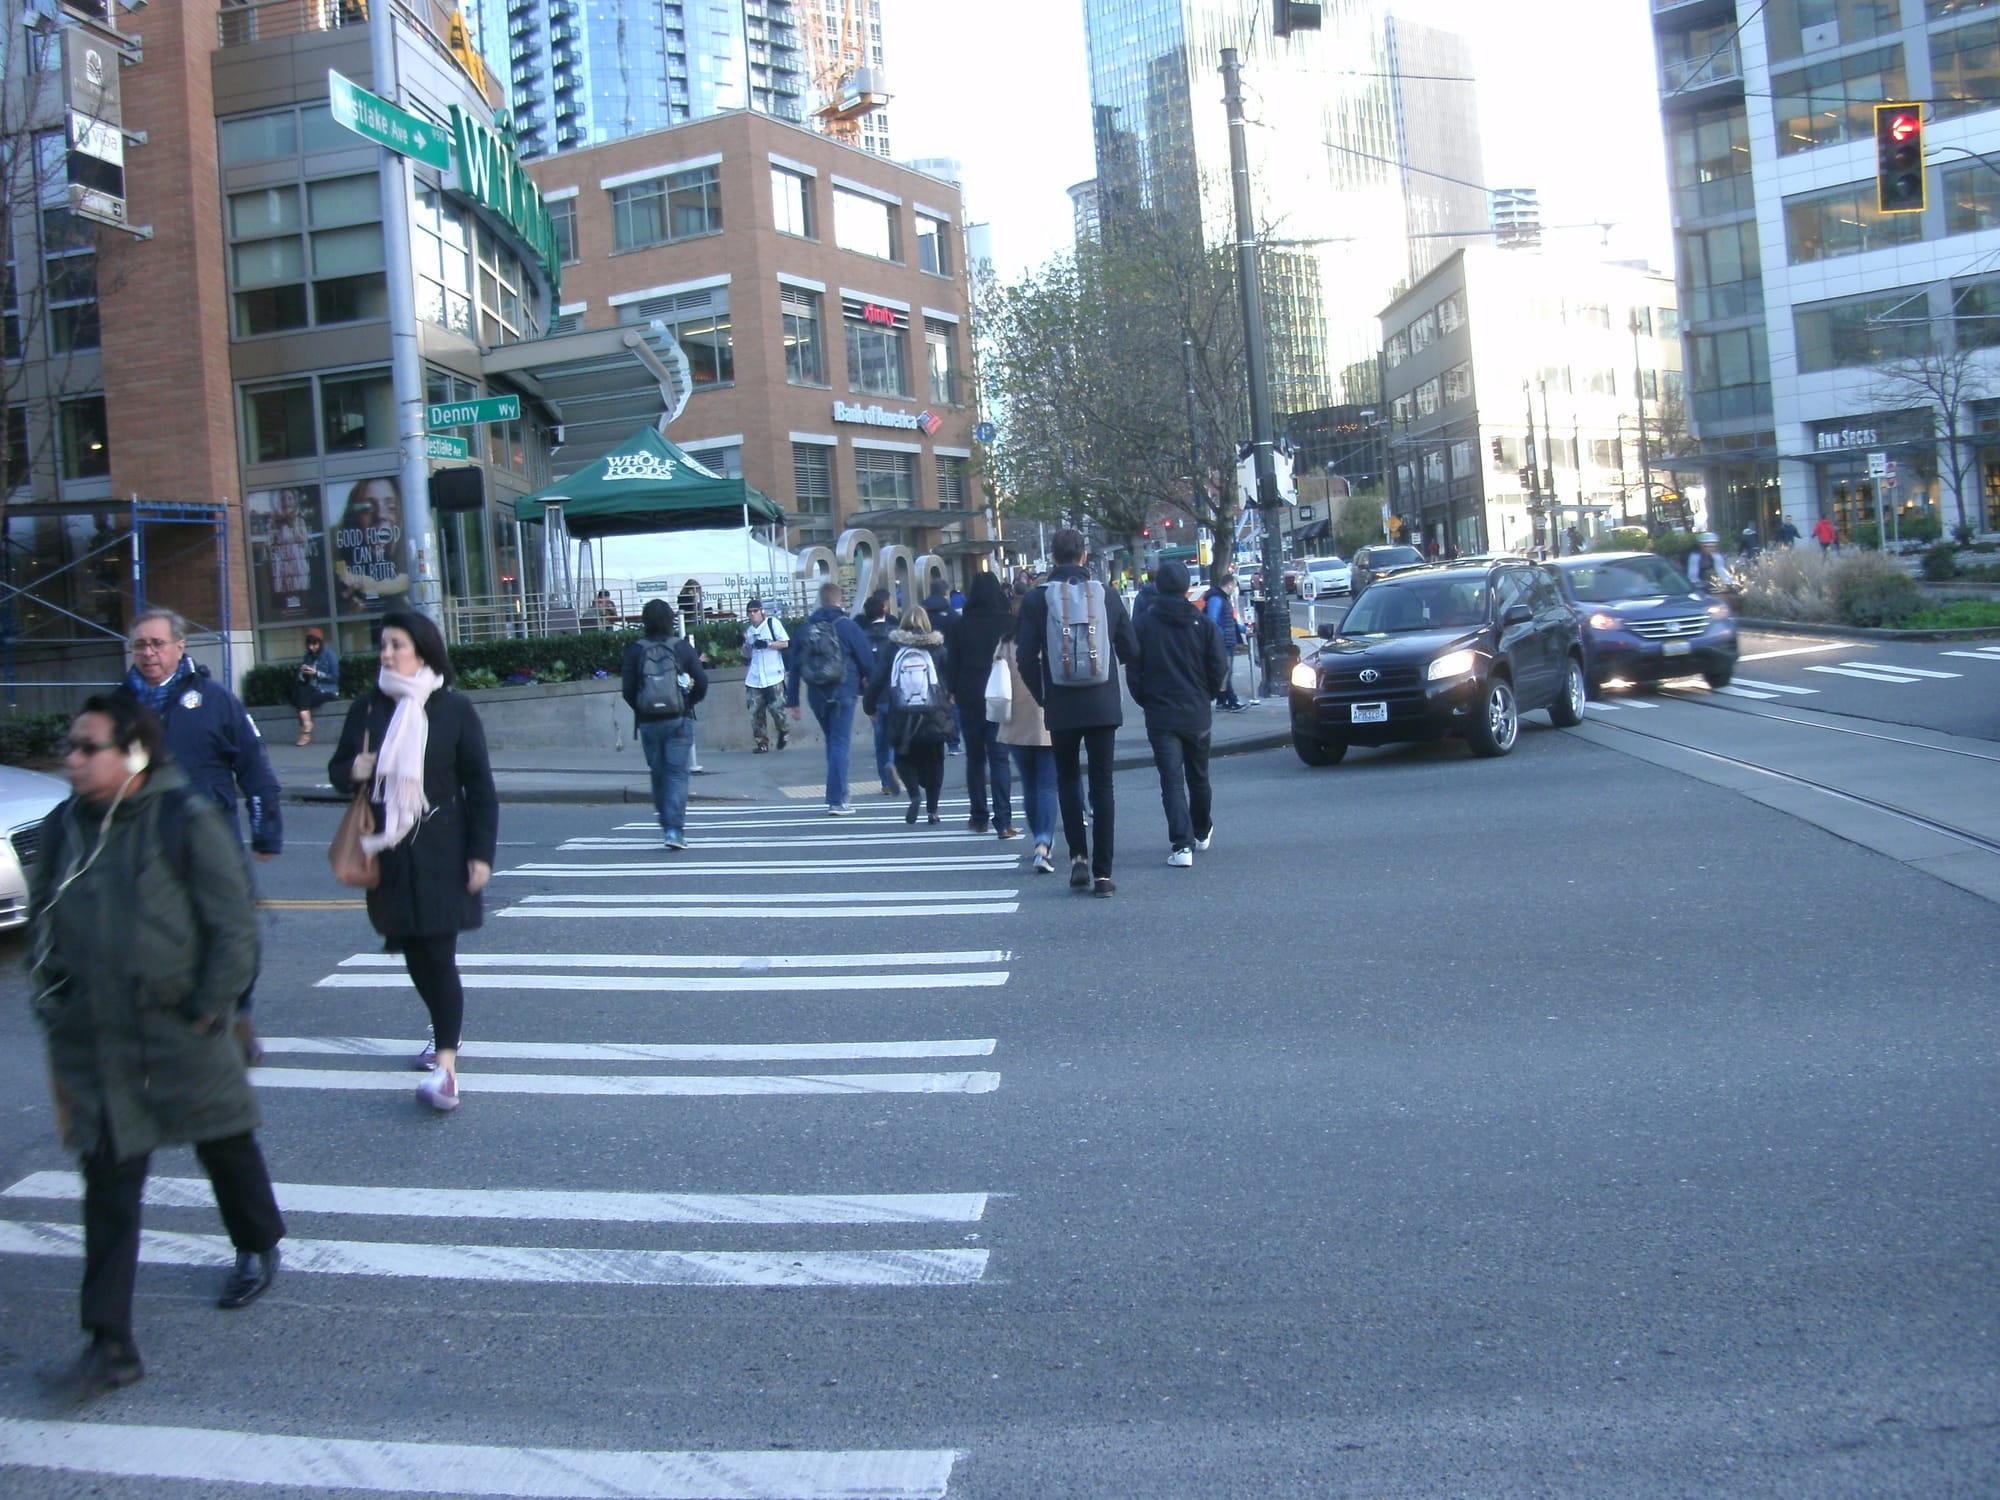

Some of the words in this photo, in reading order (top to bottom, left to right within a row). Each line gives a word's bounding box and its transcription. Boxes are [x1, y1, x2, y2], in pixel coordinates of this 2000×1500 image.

[340, 90, 388, 135] stlake
[391, 120, 408, 145] Ave
[864, 304, 895, 328] xfinity
[432, 406, 479, 425] Denny
[498, 403, 515, 418] Wy
[834, 401, 865, 423] Bank
[865, 405, 877, 424] of
[877, 406, 917, 429] America
[428, 438, 452, 456] estlake
[606, 451, 677, 470] WHOLE
[608, 465, 671, 476] FOODS
[336, 528, 363, 548] GOOD
[354, 545, 372, 564] CAN
[376, 544, 387, 563] BE
[369, 562, 397, 582] BETTER
[724, 577, 736, 589] Up
[740, 575, 775, 586] Esalato
[780, 575, 789, 584] to
[744, 588, 767, 599] Plaa
